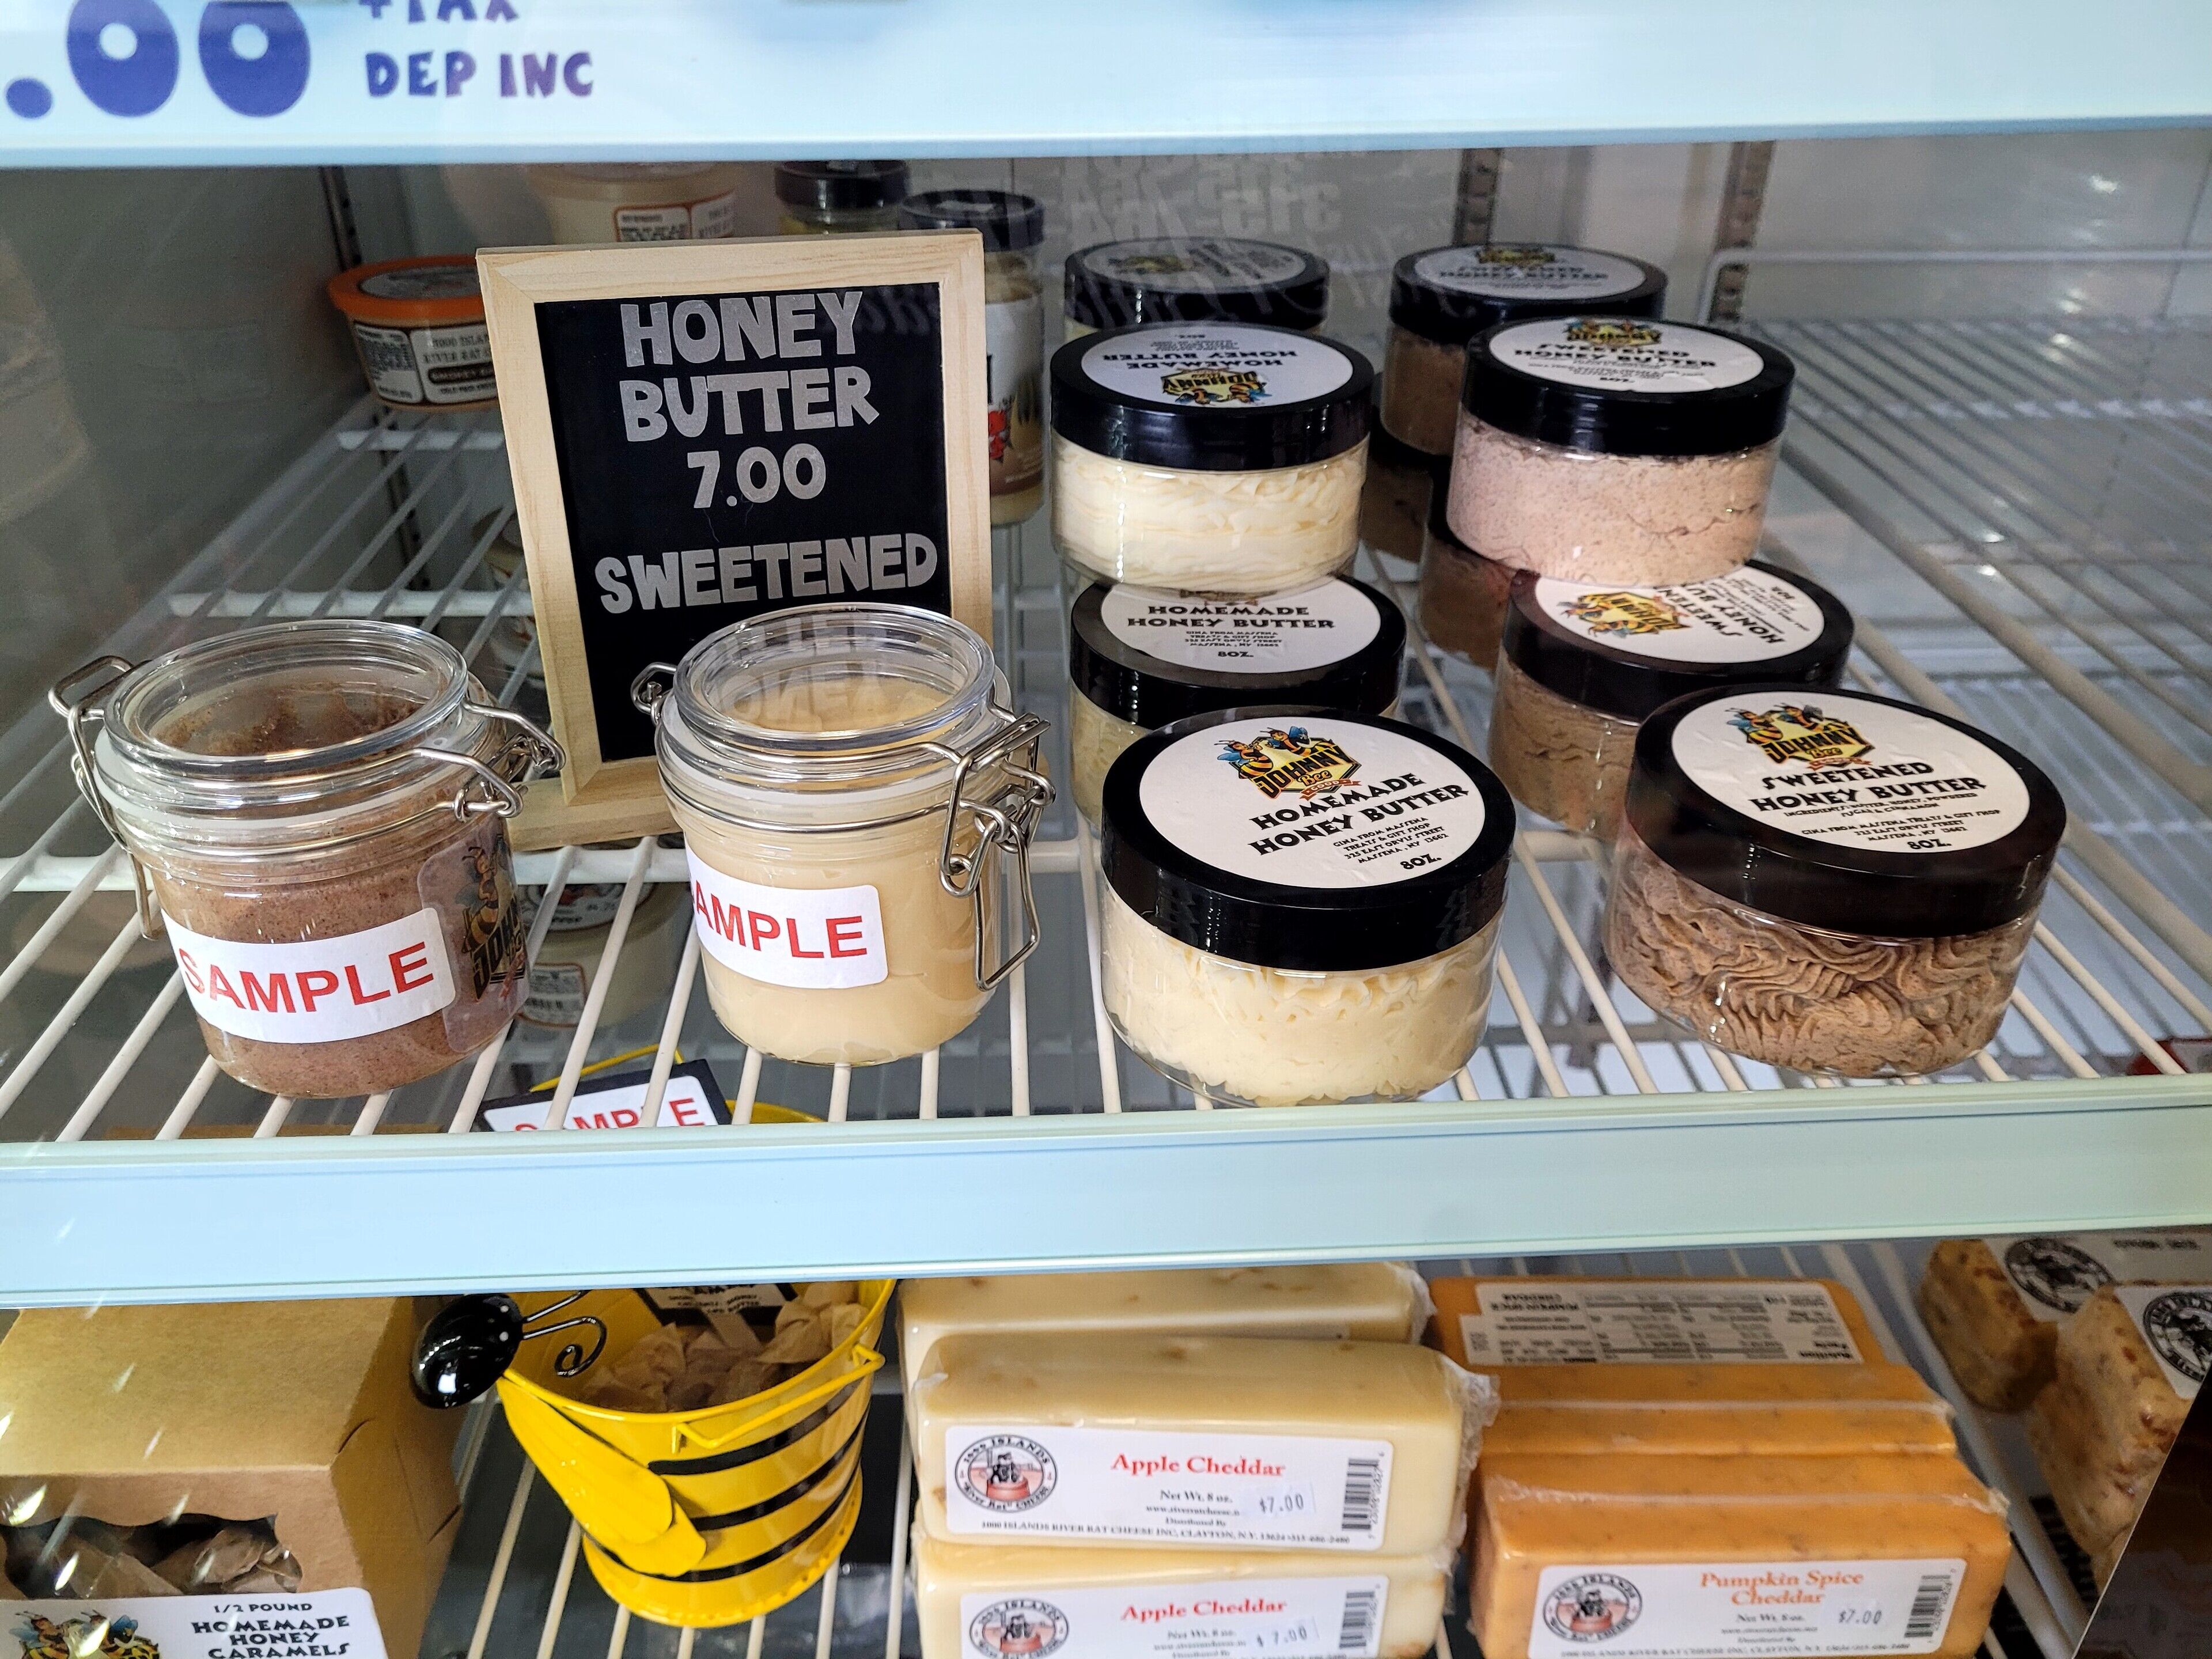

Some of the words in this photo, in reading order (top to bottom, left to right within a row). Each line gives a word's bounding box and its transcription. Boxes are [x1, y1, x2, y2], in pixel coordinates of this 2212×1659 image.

[365, 51, 476, 97] DEP
[500, 52, 592, 97] INC
[621, 291, 863, 367] HONEY
[1103, 353, 1199, 361] BUTTER
[1127, 359, 1283, 370] HOMEMADE
[1208, 350, 1298, 359] HONEY
[1515, 349, 1605, 359] HONEY
[1618, 355, 1716, 368] BUTTER
[619, 366, 879, 442] BUTTER
[687, 443, 825, 508] 7.00
[595, 533, 937, 613] SWEETENED
[1148, 605, 1309, 616] HOMEMADE
[1127, 618, 1222, 628] HONEY
[1234, 619, 1336, 630] BUTTER
[1712, 604, 1786, 644] HONEY
[1760, 726, 1870, 764] JOHNNY
[1252, 744, 1354, 800] JOHNNY
[1296, 770, 1332, 787] Bee
[1762, 762, 1935, 790] SWEETENED
[1249, 773, 1427, 831] HOMEMADE
[1749, 789, 1860, 812] HONEY
[1865, 777, 1987, 800] BUTTER
[1248, 814, 1354, 856] HONEY
[1359, 783, 1469, 823] BUTTER
[1859, 820, 1907, 828] MASSENA
[1931, 819, 1964, 828] STREET
[1333, 838, 1358, 847] GINA
[1358, 830, 1385, 840] FROM
[1385, 817, 1429, 832] MASSENA
[1343, 838, 1376, 851] TREATS
[1387, 830, 1406, 839] GIFT
[1407, 823, 1430, 834] SHOP
[1344, 851, 1361, 859] 325
[1361, 844, 1385, 855] EAST
[1385, 835, 1412, 847] ORVIS
[1416, 826, 1446, 839] STREET
[1867, 832, 1917, 841] MASSENA
[1357, 847, 1403, 863] MASSENA
[1407, 841, 1421, 849] NY
[1907, 839, 1952, 850] 8OZ.
[1400, 853, 1442, 870] 8OZ.
[694, 880, 868, 959] AMPLE
[179, 942, 435, 1013] SAMPLE
[1111, 1453, 1180, 1477] Apple
[1187, 1456, 1286, 1477] Cheddar
[1160, 1490, 1181, 1501] Net
[1259, 1493, 1305, 1515] $7.00
[1003, 1522, 1050, 1532] ISLANDS
[1701, 1571, 1800, 1590] Pumpkin
[1806, 1570, 1864, 1590] Spice
[1731, 1589, 1825, 1605] Cheddar
[214, 1604, 244, 1613] 1/2
[249, 1603, 313, 1612] POUND
[1120, 1604, 1187, 1624] Apple
[1193, 1597, 1287, 1615] Cheddar
[1839, 1609, 1883, 1625] $7.00
[191, 1616, 350, 1634] HOMEMADE
[229, 1632, 320, 1646] HONEY
[208, 1643, 350, 1659] CARAMELS
